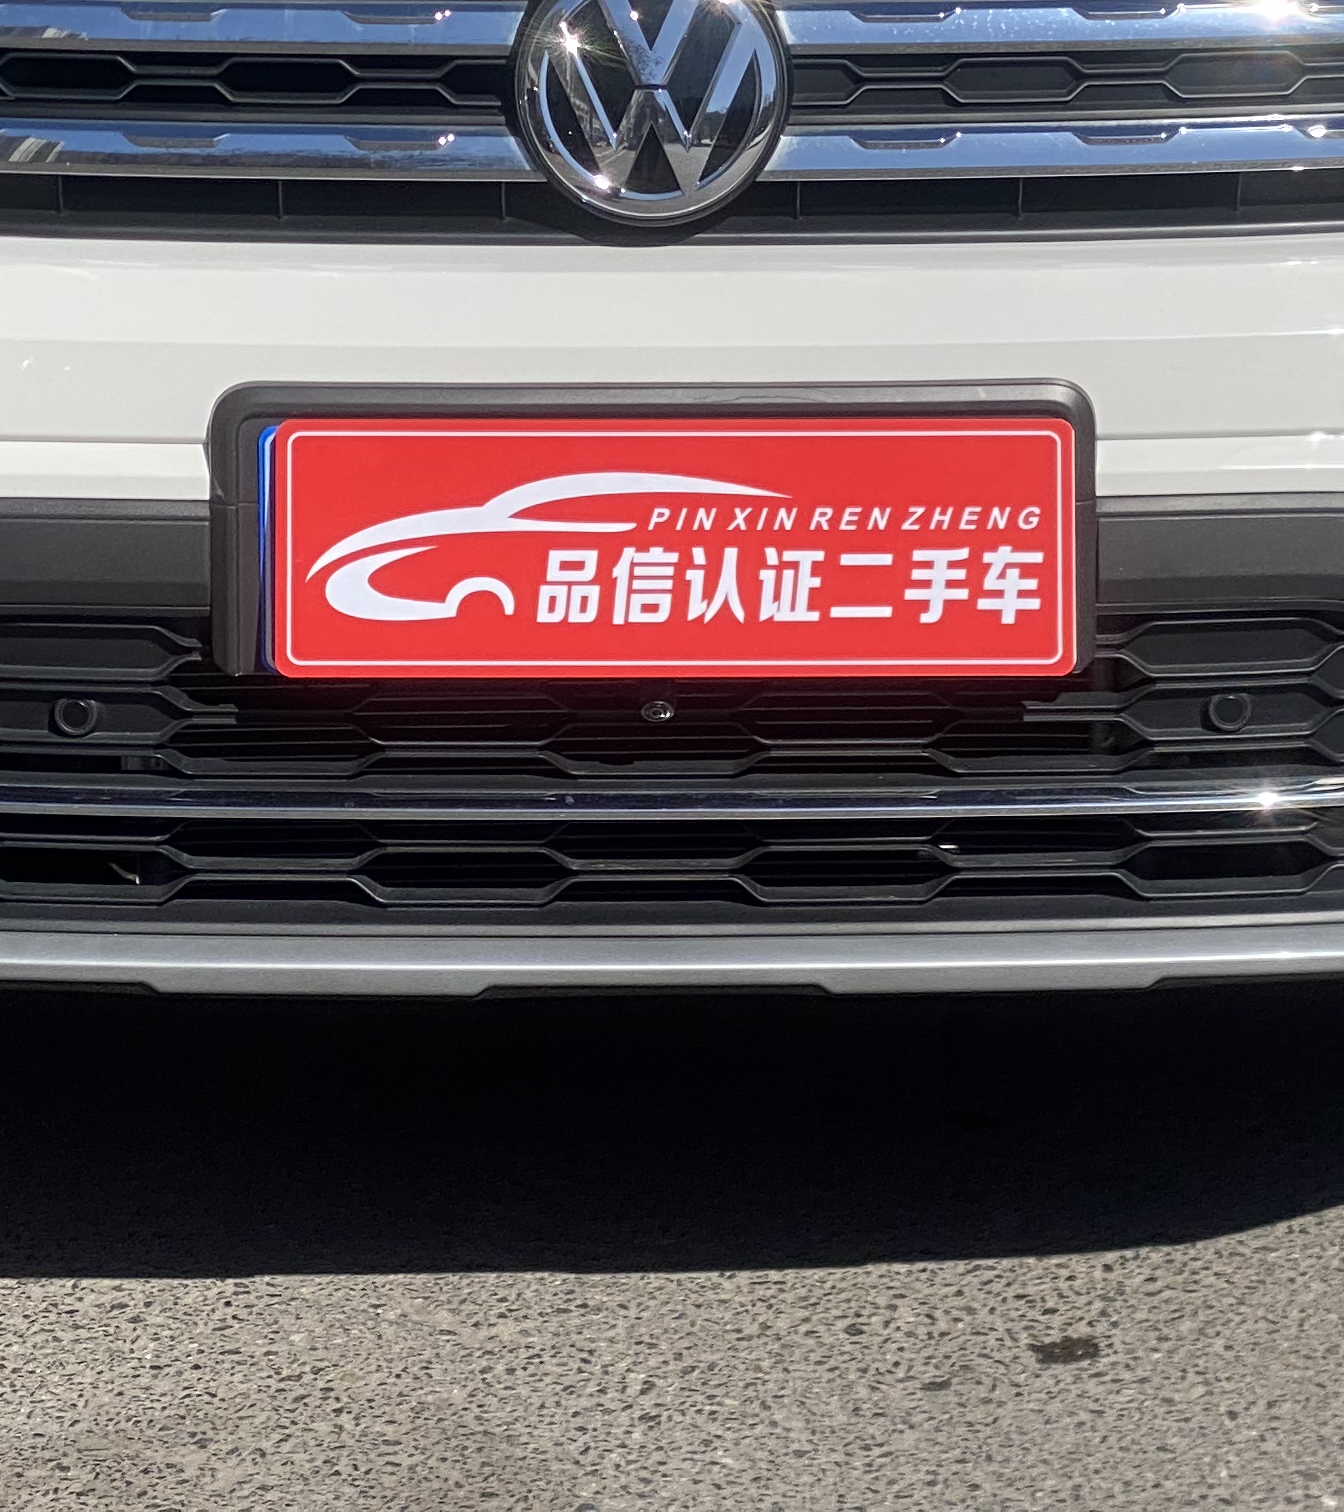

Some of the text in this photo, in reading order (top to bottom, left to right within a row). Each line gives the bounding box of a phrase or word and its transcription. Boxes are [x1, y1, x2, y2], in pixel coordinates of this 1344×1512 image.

[647, 505, 1042, 531] PIN XIN REN ZHENG
[535, 545, 1046, 626] 品信认证二手车
